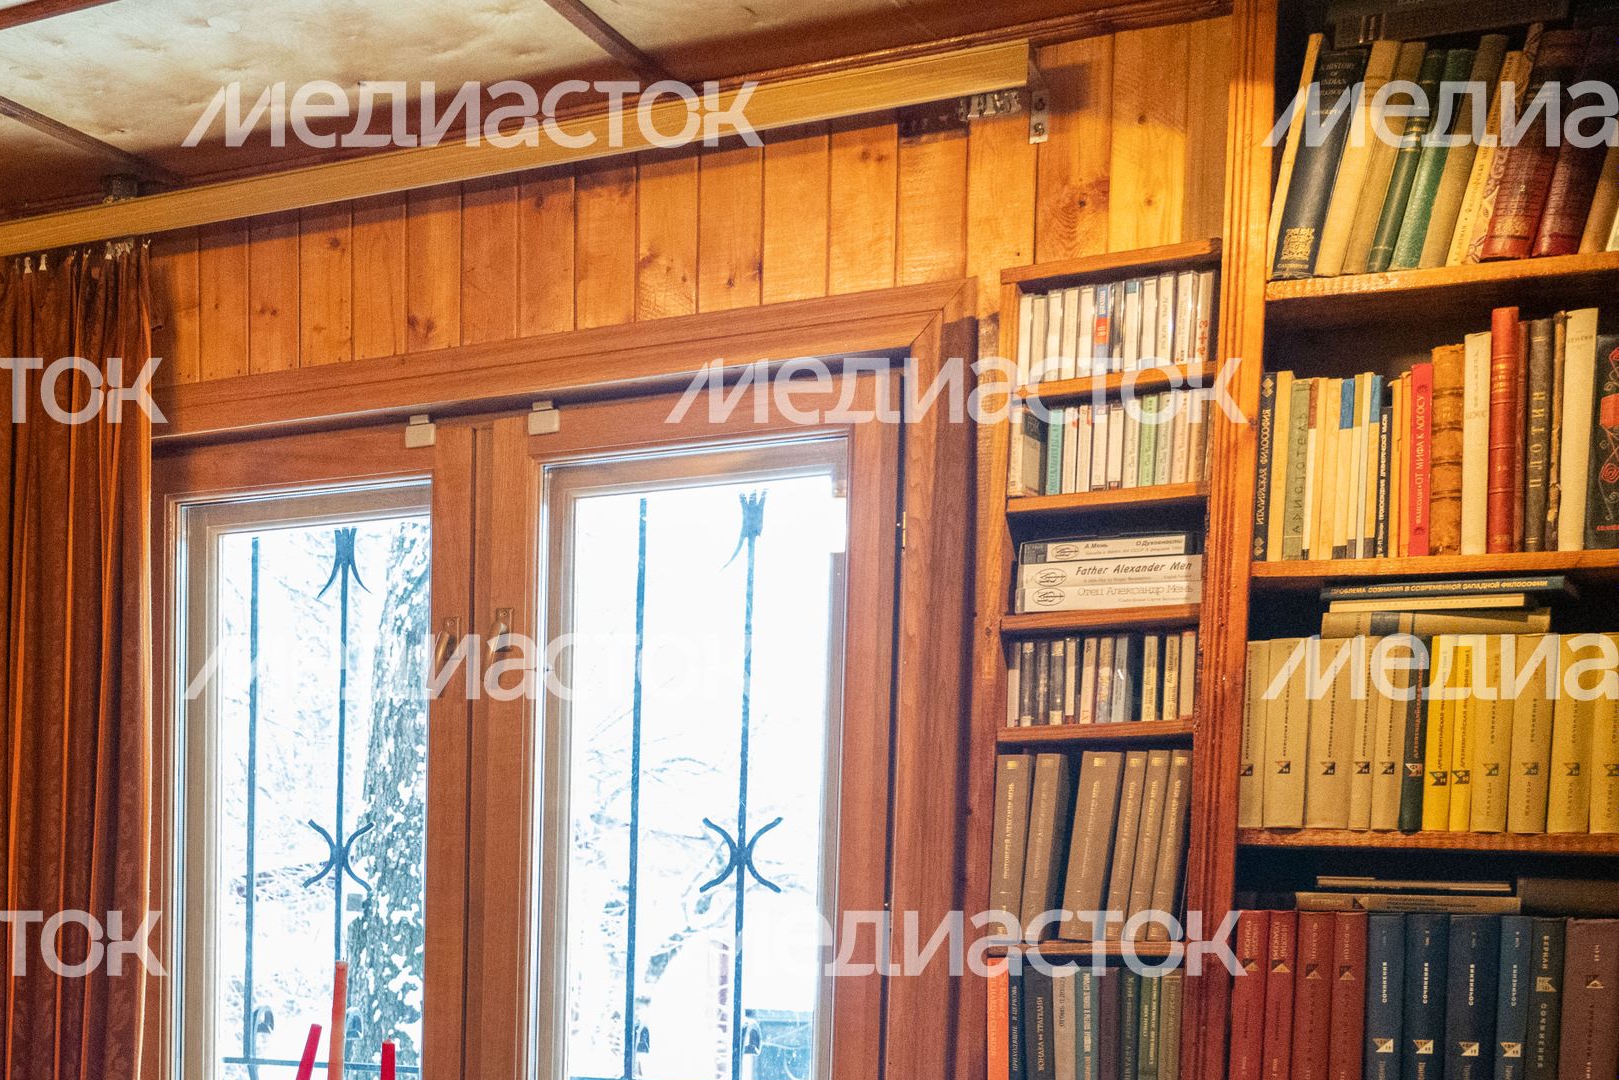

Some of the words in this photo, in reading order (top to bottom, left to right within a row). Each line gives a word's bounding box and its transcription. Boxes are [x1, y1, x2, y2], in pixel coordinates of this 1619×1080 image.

[1416, 394, 1427, 431] ЛОГОСУ
[1415, 441, 1425, 470] МИФА
[1530, 390, 1546, 488] ПЛОТИН
[1076, 566, 1108, 575] Father
[1113, 563, 1165, 574] Alexander
[1170, 562, 1192, 570] Men
